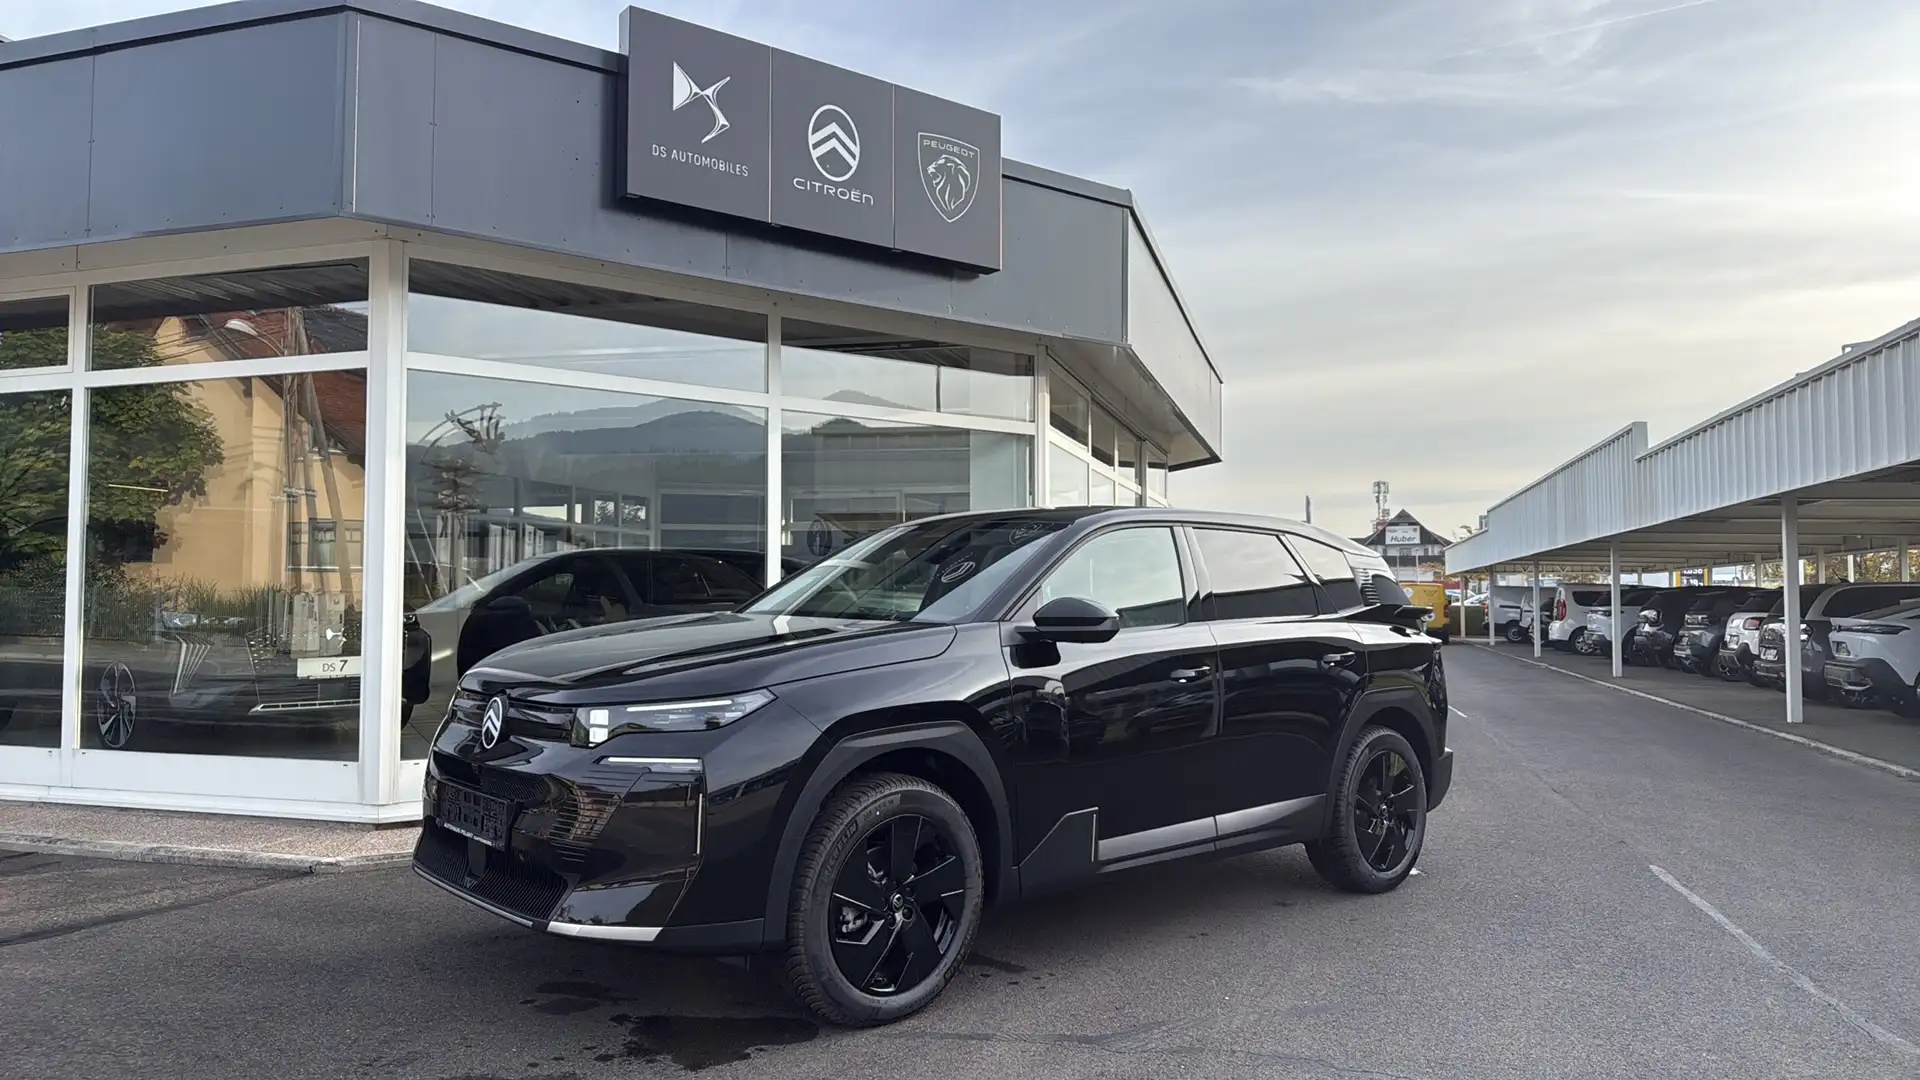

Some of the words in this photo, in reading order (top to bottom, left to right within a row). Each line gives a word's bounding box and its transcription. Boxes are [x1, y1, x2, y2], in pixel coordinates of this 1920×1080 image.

[923, 139, 976, 158] PEUGEOT
[652, 144, 667, 158] DS
[671, 150, 749, 177] AUTOMOBILES
[1391, 535, 1417, 543] Huber
[322, 662, 336, 672] DS
[340, 659, 348, 672] 7
